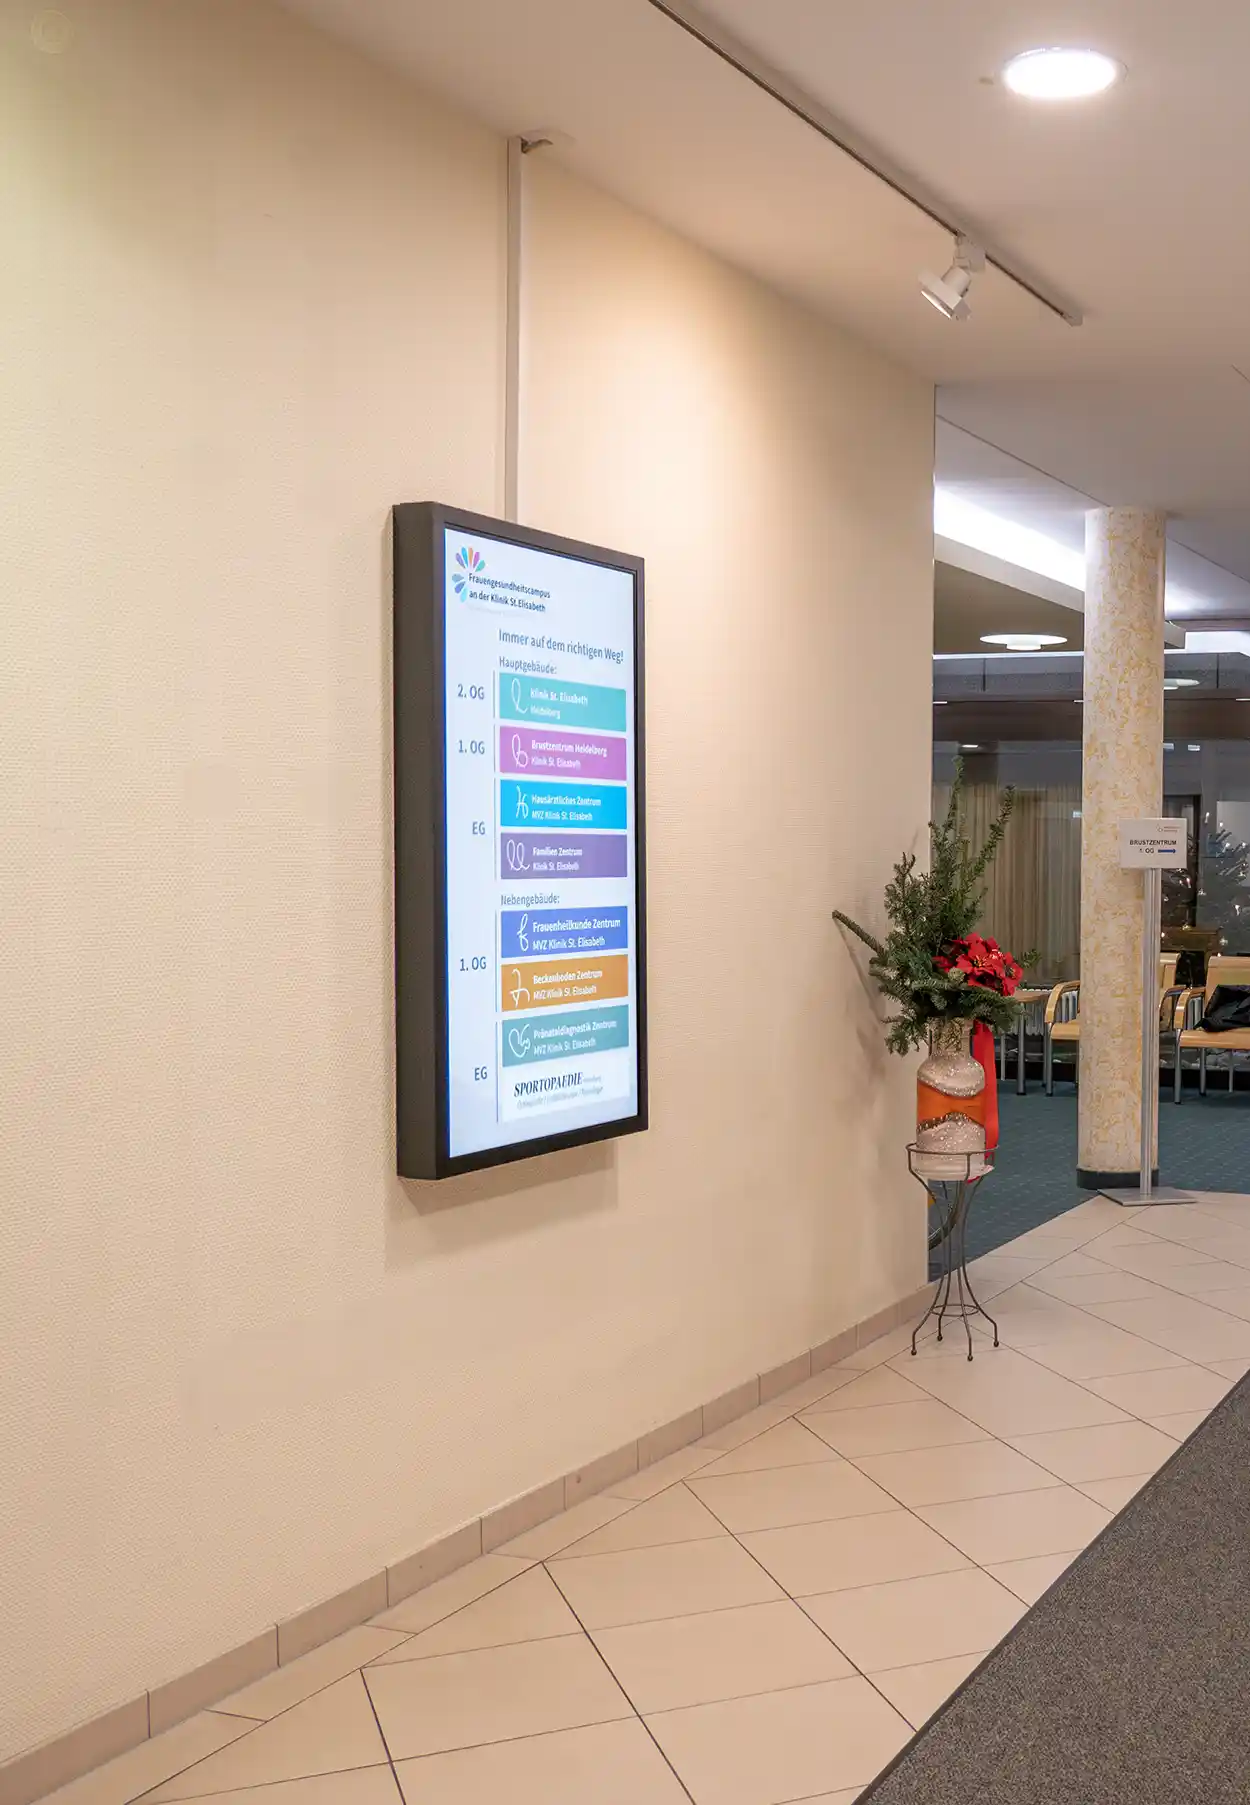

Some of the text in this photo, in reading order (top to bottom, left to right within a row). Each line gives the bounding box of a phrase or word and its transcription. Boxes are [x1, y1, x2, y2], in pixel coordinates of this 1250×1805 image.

[468, 573, 551, 599] Frauengesundheitscampus
[469, 590, 478, 598] an
[478, 591, 490, 601] der
[491, 593, 509, 605] Klinik
[498, 629, 624, 664] Immer auf dem richtigen Weg!
[499, 656, 557, 674] Hauptgebäude:
[457, 684, 485, 699] 2. OG
[530, 688, 589, 706] Klinik St. Elisabeth
[458, 740, 485, 754] 1. OG
[531, 740, 607, 758] Brustzentrum Heidelberg
[531, 755, 548, 766] Klinik
[531, 794, 601, 806] Hausärztliches Zentrum
[531, 810, 544, 819] MVZ
[545, 811, 560, 820] Klinik
[472, 821, 486, 835] EG
[532, 846, 583, 857] Familien Zentrum
[532, 862, 548, 871] Klinik
[500, 893, 560, 907] Nebengebäude:
[532, 918, 621, 933] Frauenheilkunde Zentrum
[532, 936, 605, 950] MVZ Klinik St. Elisabeth
[459, 956, 487, 971] 1. OG
[532, 970, 603, 985] Beckenboden Zentrum
[533, 990, 548, 1000] MVZ
[548, 989, 563, 999] Klinik
[592, 1020, 617, 1031] Zentrum
[533, 1045, 547, 1055] MVZ
[547, 1043, 564, 1053] Klinik
[474, 1066, 488, 1081] EG
[513, 1071, 583, 1098] SPORTOPAEDIE
